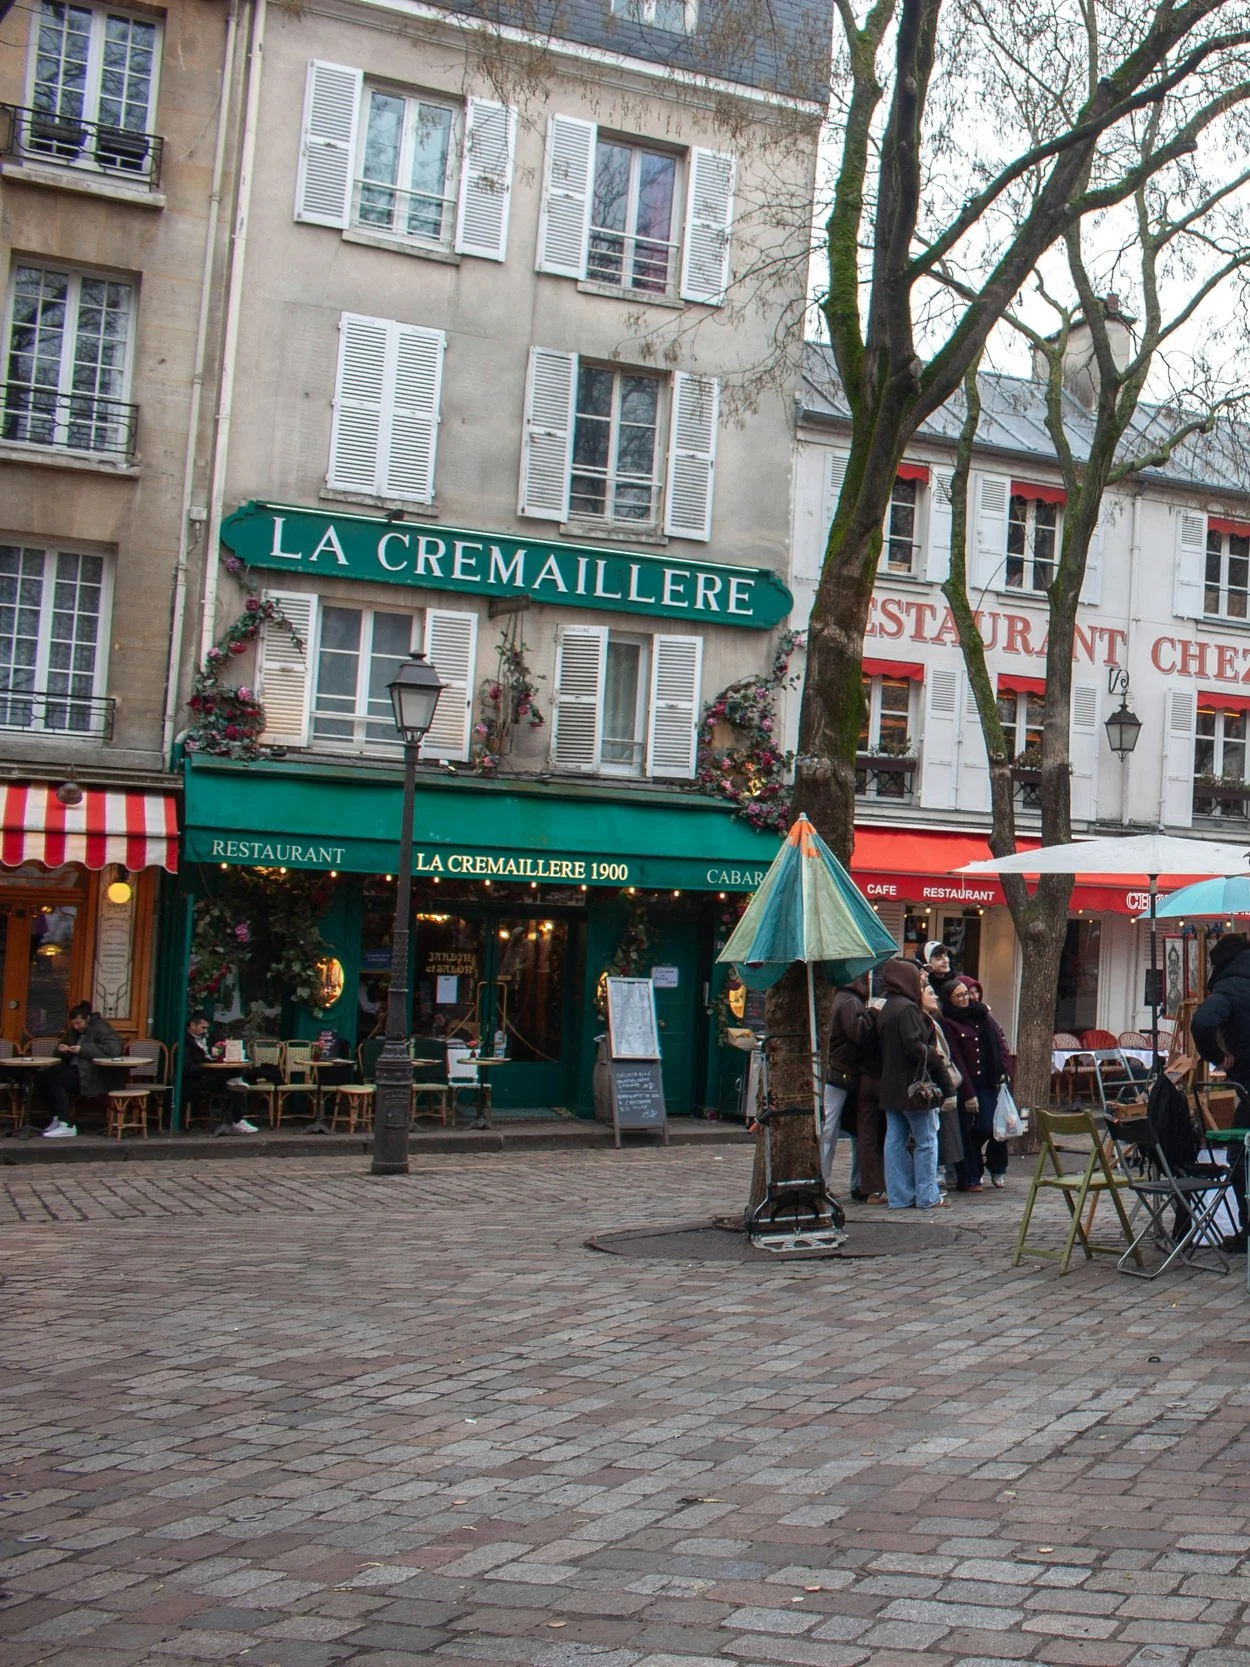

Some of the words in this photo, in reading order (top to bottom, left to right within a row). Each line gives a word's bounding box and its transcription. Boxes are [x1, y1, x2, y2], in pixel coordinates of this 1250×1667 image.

[269, 516, 350, 566] LA
[377, 532, 755, 617] CREMAILLERE
[864, 596, 1127, 669] STAURNT
[211, 839, 346, 864] RESTAURANT
[416, 853, 445, 872] LA
[447, 855, 586, 879] CREMAILLERE
[590, 862, 629, 881] 1900
[706, 869, 769, 885] CABAR
[866, 884, 897, 896] CAFE
[923, 887, 995, 901] RESTAURANT
